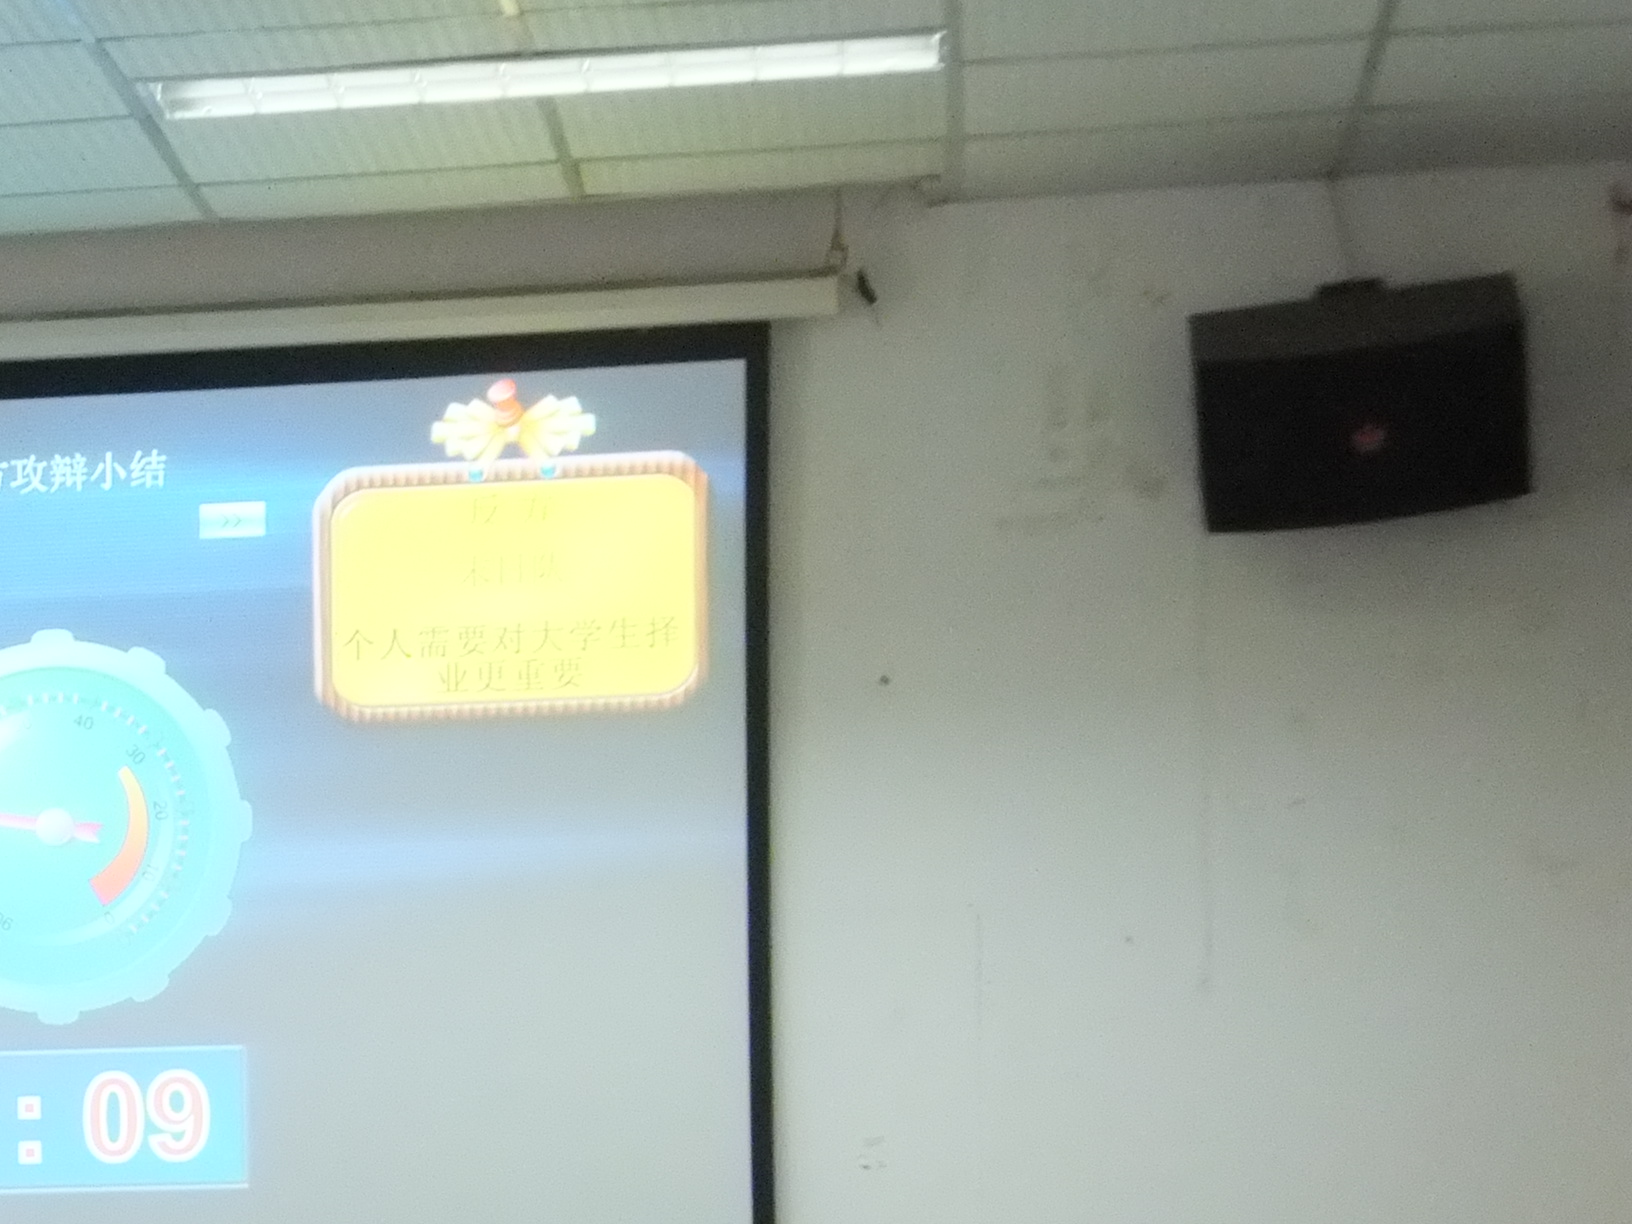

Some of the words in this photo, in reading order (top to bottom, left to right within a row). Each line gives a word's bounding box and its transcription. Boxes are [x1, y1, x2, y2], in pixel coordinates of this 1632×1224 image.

[342, 615, 680, 662] 个人需要对大学生择
[437, 657, 584, 694] 业更重要
